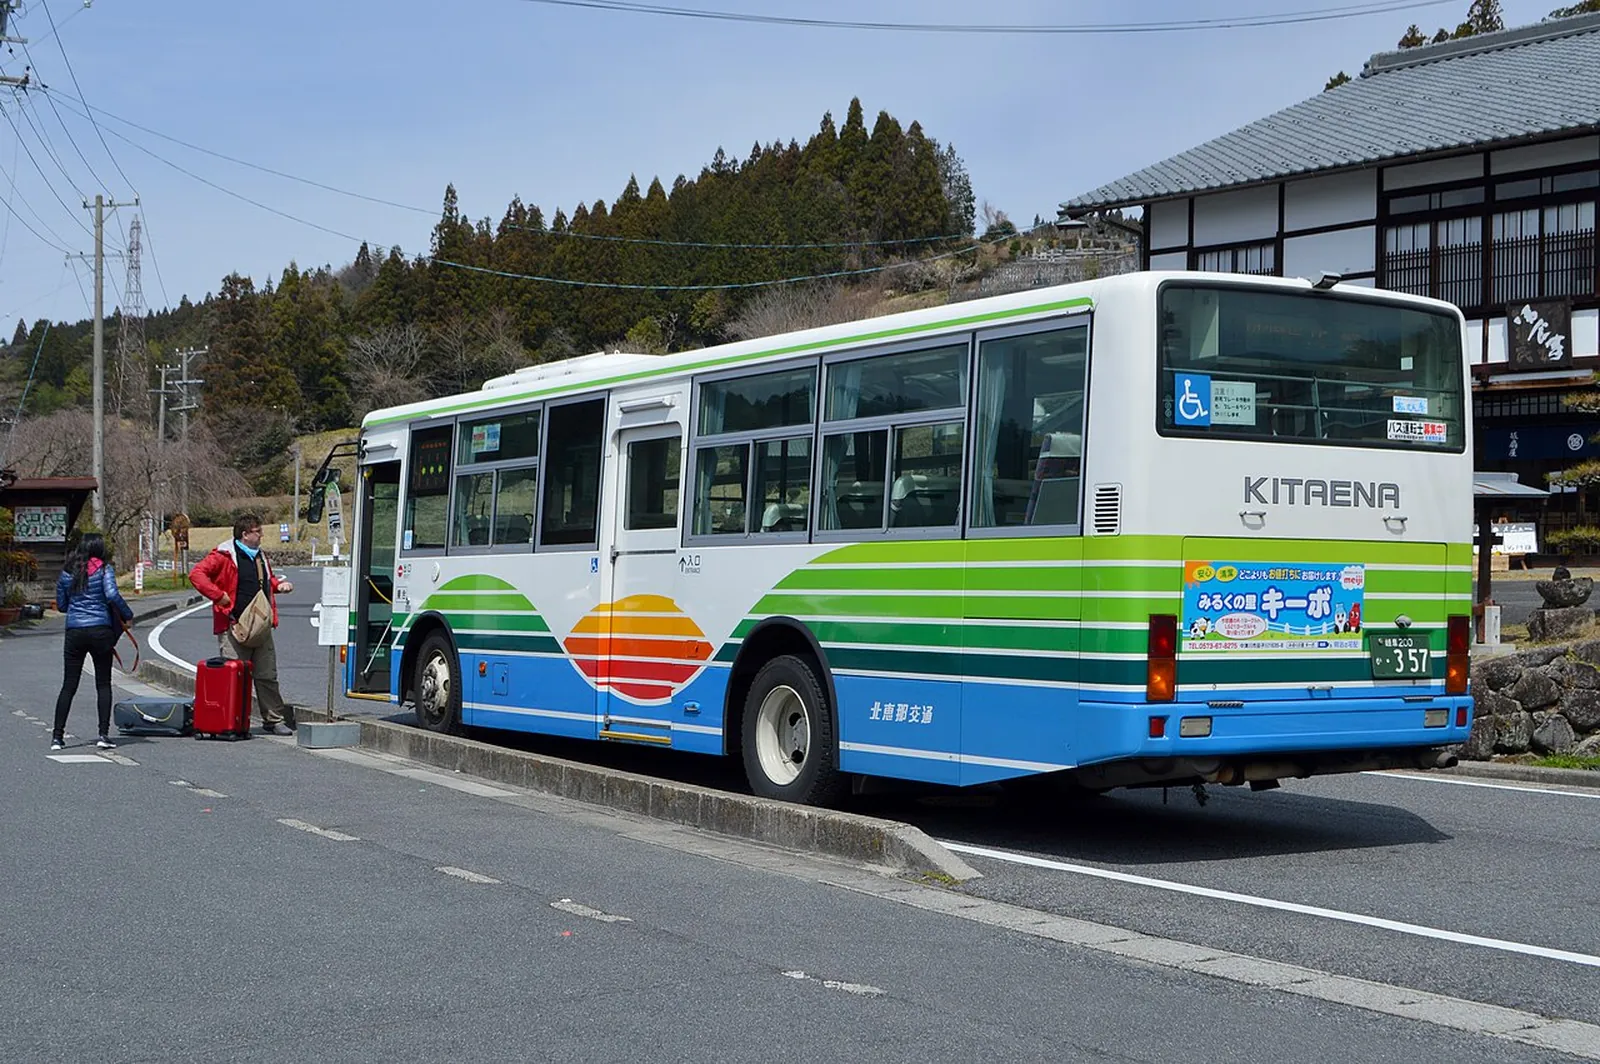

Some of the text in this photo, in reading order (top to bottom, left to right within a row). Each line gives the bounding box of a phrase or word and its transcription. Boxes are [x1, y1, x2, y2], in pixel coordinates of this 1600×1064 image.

[1244, 476, 1400, 509] KITAENA
[1343, 575, 1363, 586] meiji
[1198, 587, 1332, 619] みるくの里 キーボ
[869, 700, 934, 724] 北恵那交通
